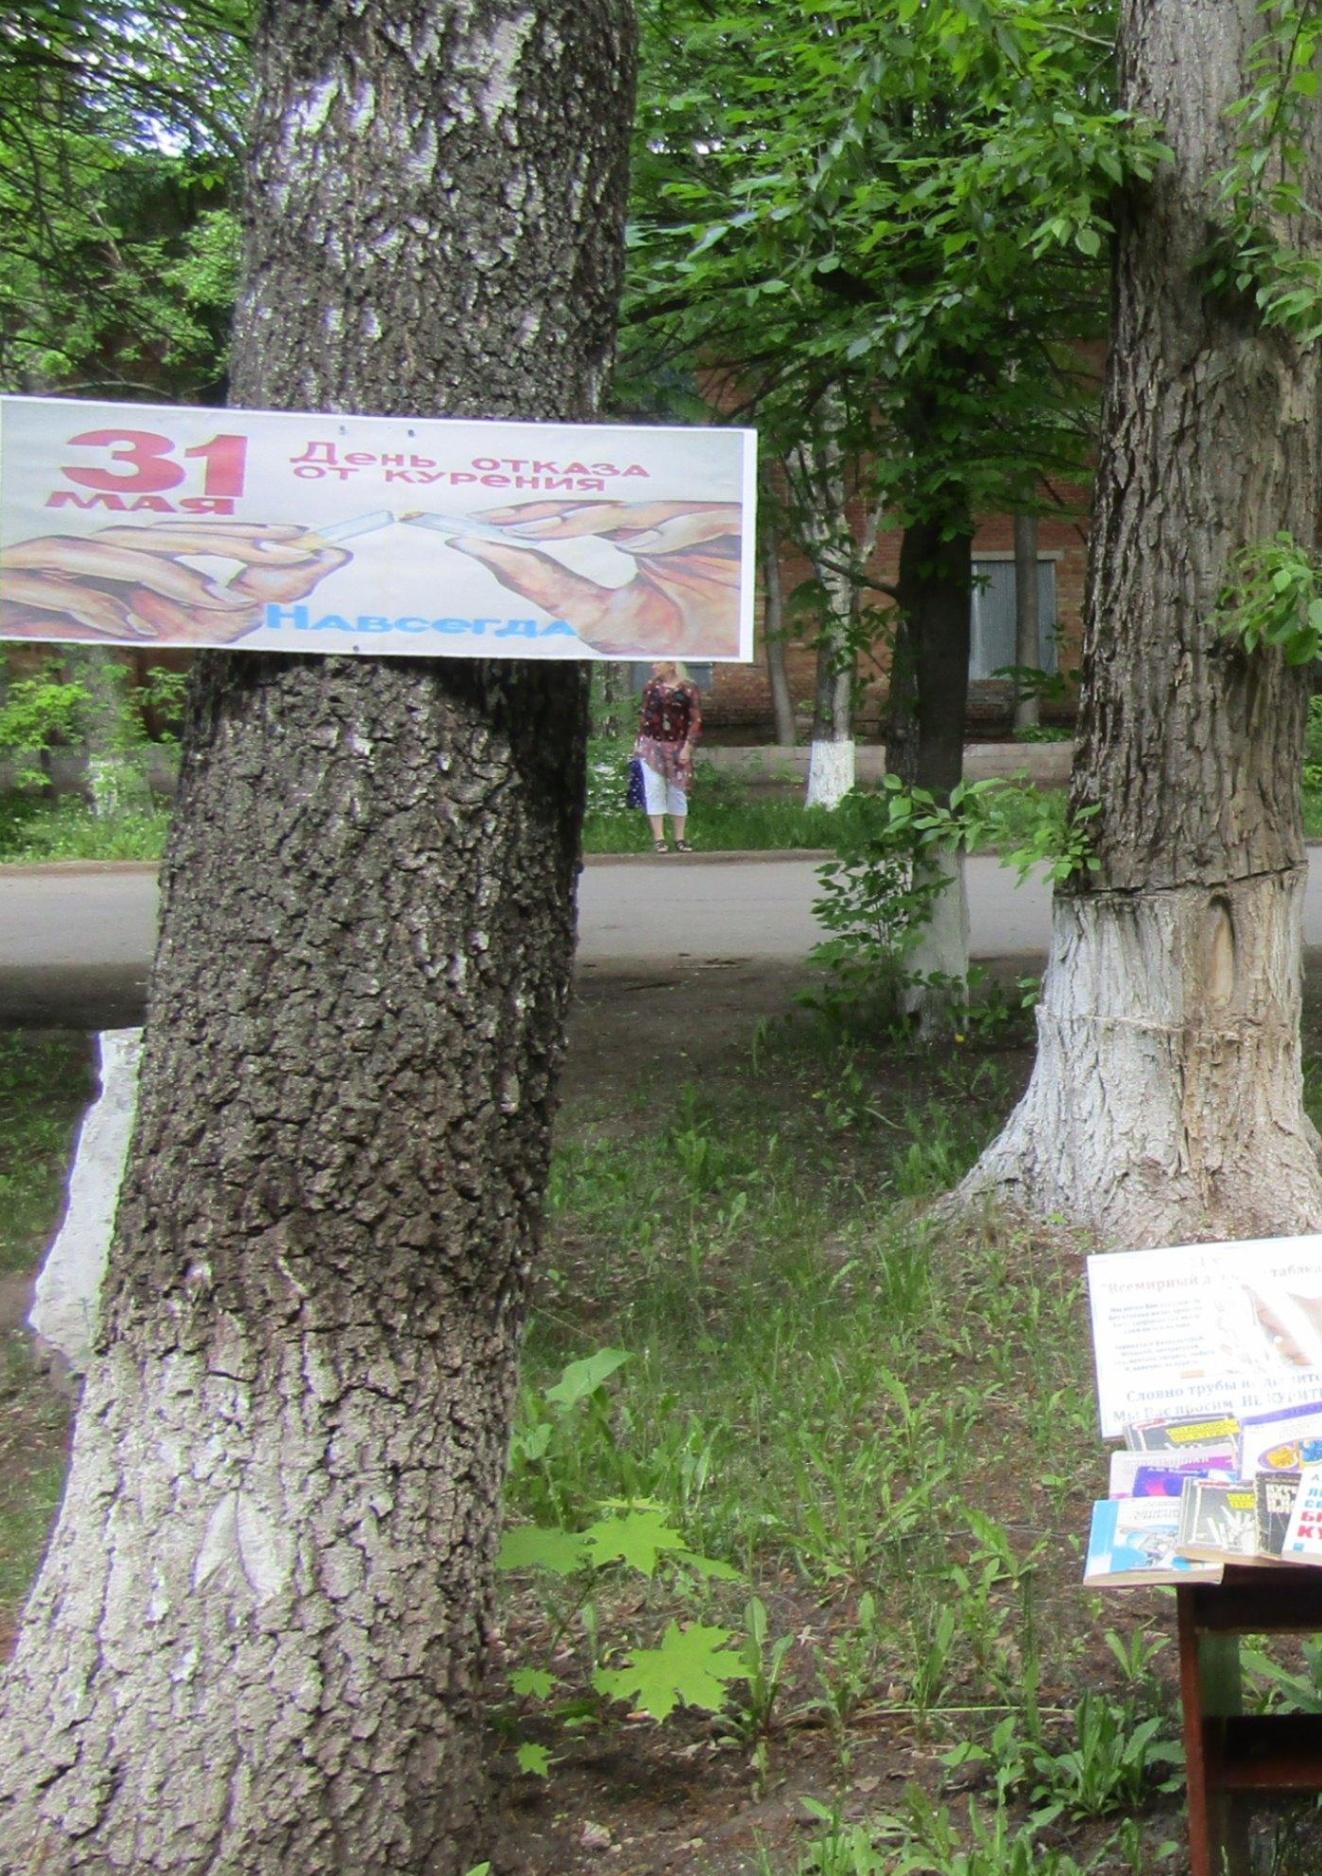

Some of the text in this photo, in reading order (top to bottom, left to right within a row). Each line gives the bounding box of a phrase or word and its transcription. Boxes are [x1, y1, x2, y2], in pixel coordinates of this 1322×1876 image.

[61, 428, 248, 497] 31
[289, 441, 437, 468] День
[293, 465, 605, 492] от курения
[1125, 1383, 1185, 1403] Словно
